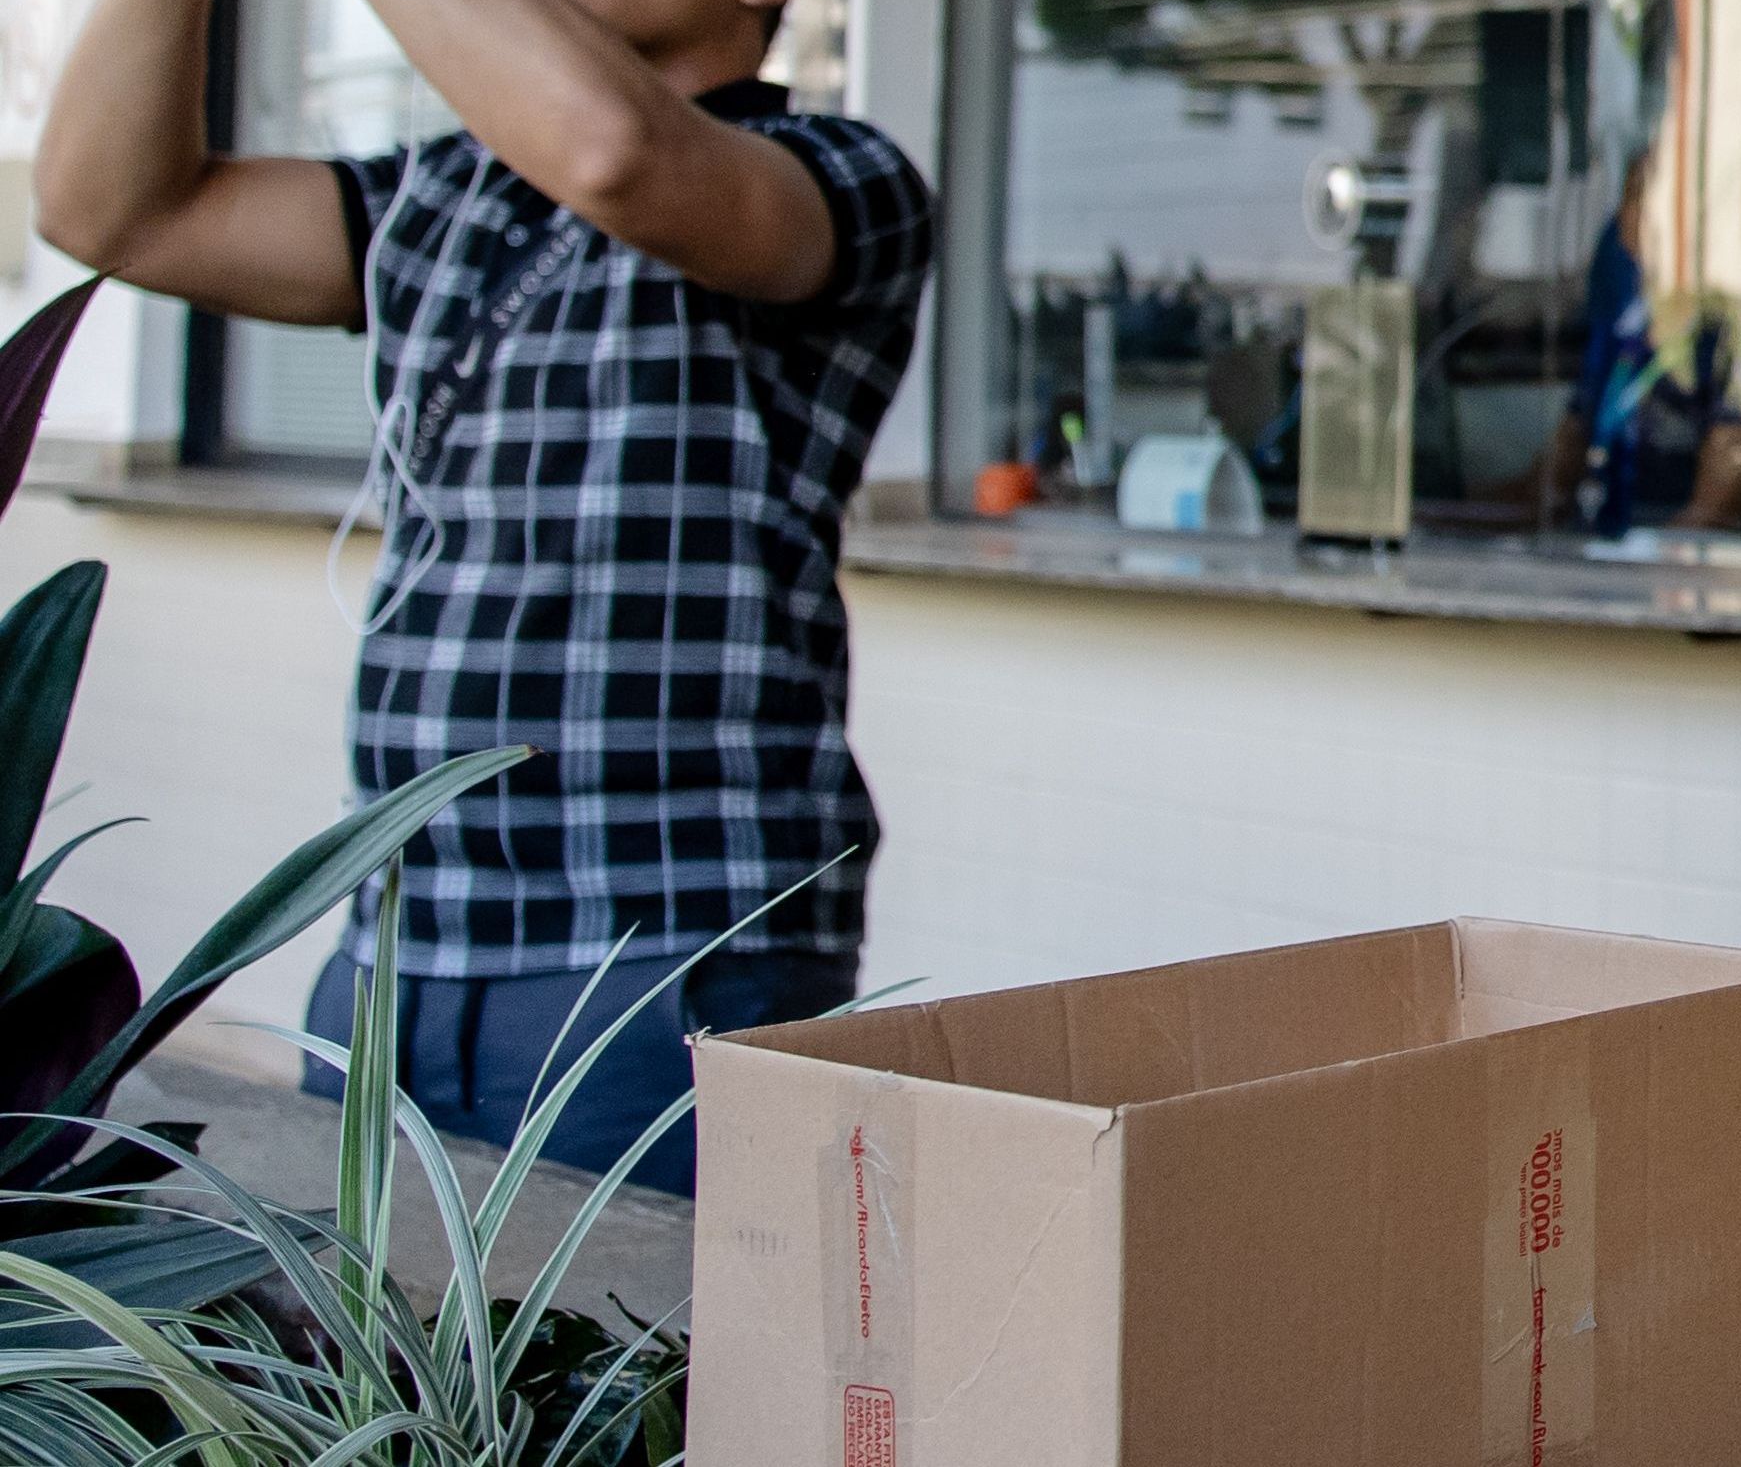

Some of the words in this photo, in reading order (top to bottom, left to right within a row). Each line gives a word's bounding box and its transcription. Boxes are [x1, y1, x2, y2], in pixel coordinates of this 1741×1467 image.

[1553, 1178, 1564, 1219] mais
[1552, 1224, 1564, 1249] de
[847, 1395, 855, 1417] DO
[882, 1399, 891, 1439] ESTA
